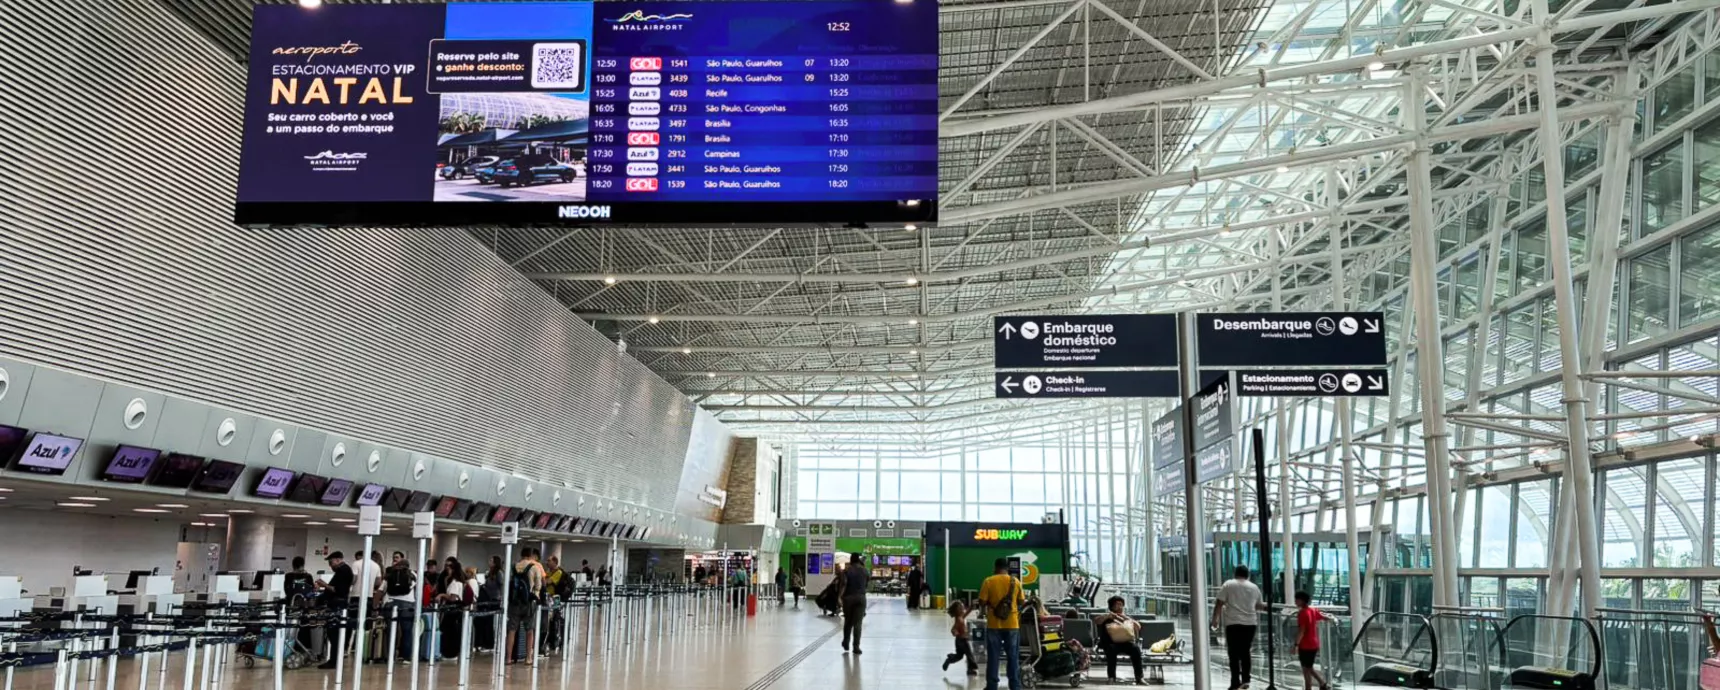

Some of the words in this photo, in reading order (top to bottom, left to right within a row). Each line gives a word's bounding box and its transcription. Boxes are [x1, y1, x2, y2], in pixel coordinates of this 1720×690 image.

[827, 22, 850, 31] 12:52
[272, 40, 363, 62] aeroporto
[478, 52, 499, 61] pelo
[502, 52, 519, 60] site
[445, 63, 475, 72] ganhe
[477, 63, 525, 71] desconto:
[631, 58, 662, 70] GOL
[706, 59, 720, 67] São
[722, 60, 744, 68] Paulo,
[745, 59, 783, 67] Guarulhos
[804, 59, 814, 67] 07
[272, 64, 390, 75] ESTACIONAMENTO
[393, 64, 415, 74] VIP
[706, 74, 720, 82] São
[722, 74, 743, 82] Paulo,
[745, 74, 783, 82] Guarulhos
[270, 77, 414, 104] NATAL
[705, 89, 728, 97] Recife
[705, 104, 719, 112] São
[721, 104, 743, 113] Paulo,
[744, 104, 786, 113] Congonhas
[829, 104, 848, 112] 16:05
[268, 113, 287, 121] Seu
[318, 113, 358, 121] coberto
[370, 112, 394, 121] você
[829, 119, 848, 127] 16:35
[294, 126, 324, 134] passo
[326, 124, 340, 132] do
[342, 124, 394, 133] embarque
[630, 133, 659, 145] GOL
[829, 134, 848, 142] 17:10
[668, 150, 686, 158] 2912
[704, 150, 740, 158] Campinas
[829, 149, 848, 157] 17:30
[704, 165, 718, 173] São
[720, 165, 742, 173] Paulo,
[744, 165, 781, 173] Guarulhos
[629, 178, 658, 191] GOL
[704, 180, 718, 188] São
[719, 180, 742, 188] Paulo,
[743, 180, 780, 188] Guarulhos
[828, 180, 848, 188] 18:20
[559, 205, 611, 218] NEOOH
[1043, 322, 1114, 335] Embarque
[1214, 318, 1312, 332] Desembarque
[1043, 334, 1117, 346] doméstico
[1046, 376, 1084, 384] Check-in
[1242, 374, 1314, 382] Estacionamento
[30, 443, 59, 459] Azul
[115, 454, 141, 469] Azul
[974, 529, 1027, 540] SUBWAY
